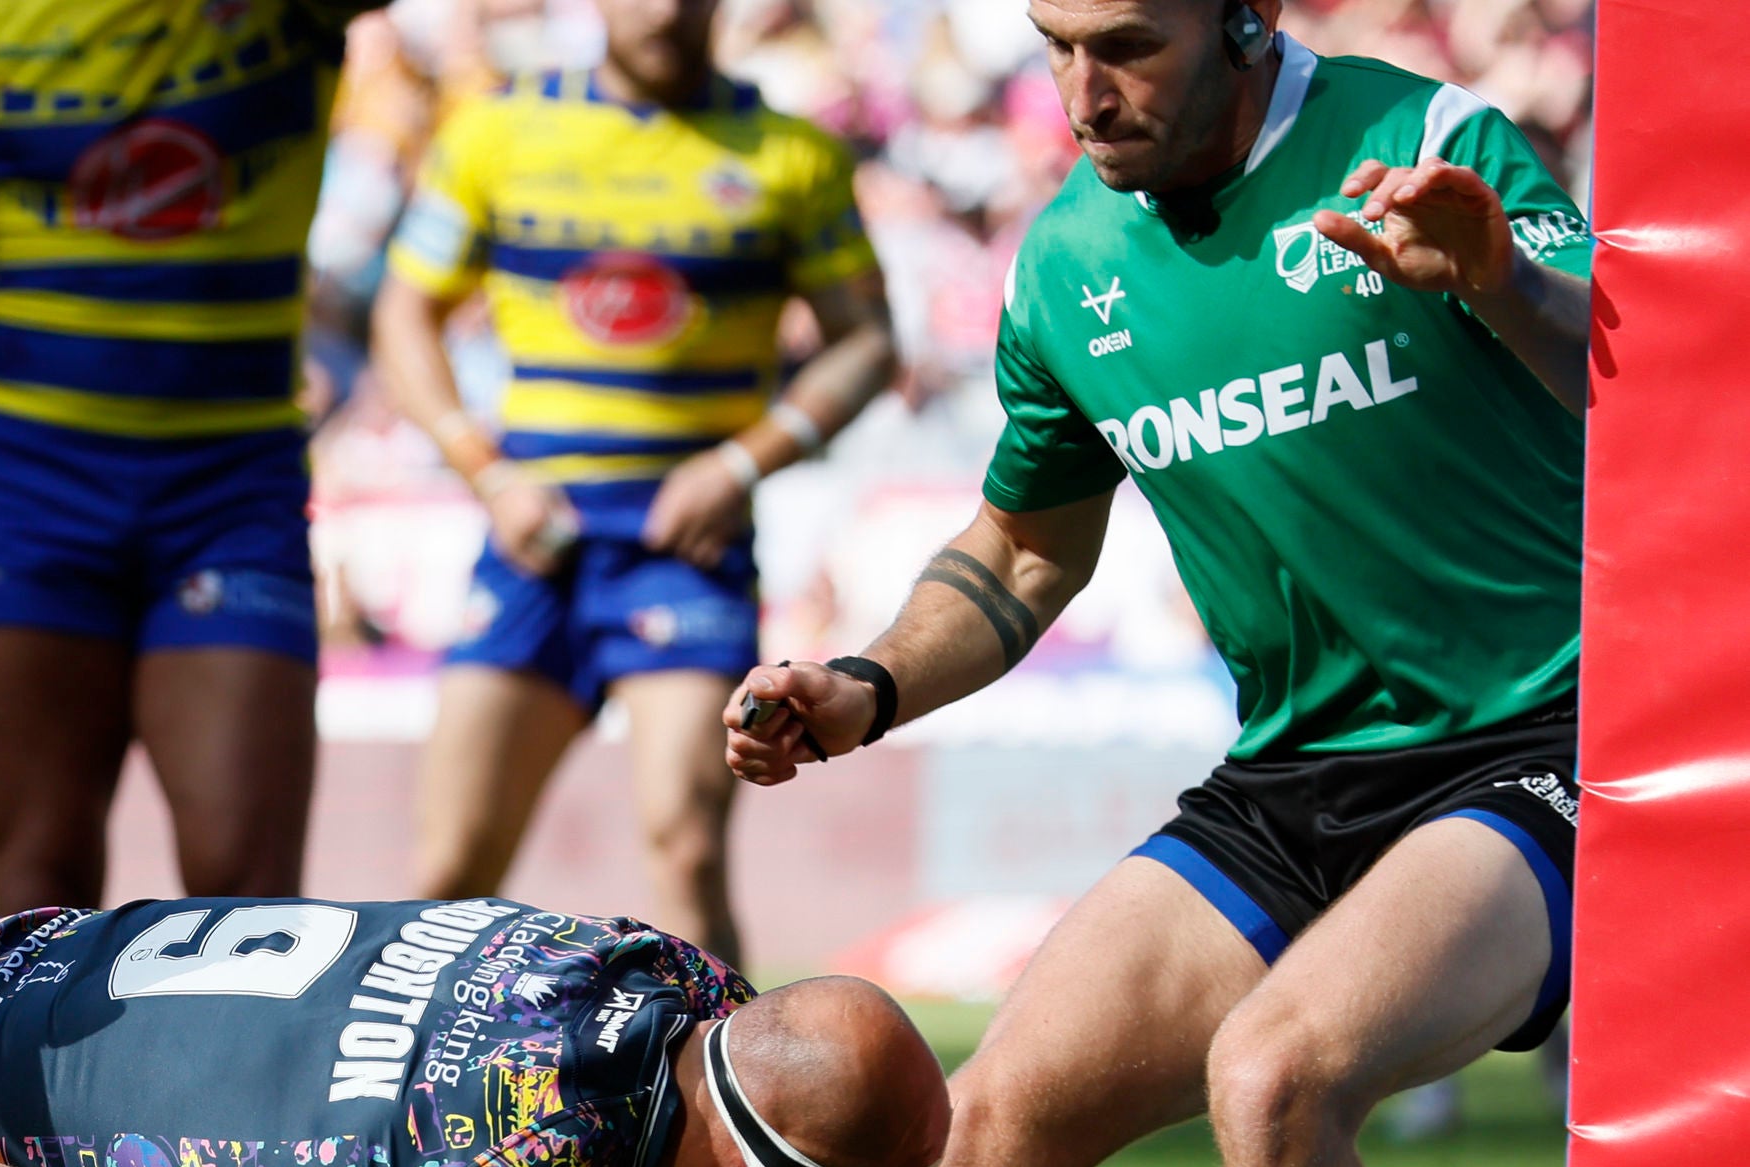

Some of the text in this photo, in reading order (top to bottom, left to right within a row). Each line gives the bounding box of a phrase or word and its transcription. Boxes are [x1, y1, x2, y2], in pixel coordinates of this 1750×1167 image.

[1355, 270, 1384, 297] 40
[1088, 328, 1132, 357] OXEN
[1095, 339, 1418, 474] RONSEAL
[109, 904, 357, 1000] 9
[424, 912, 567, 1088] Cladingking
